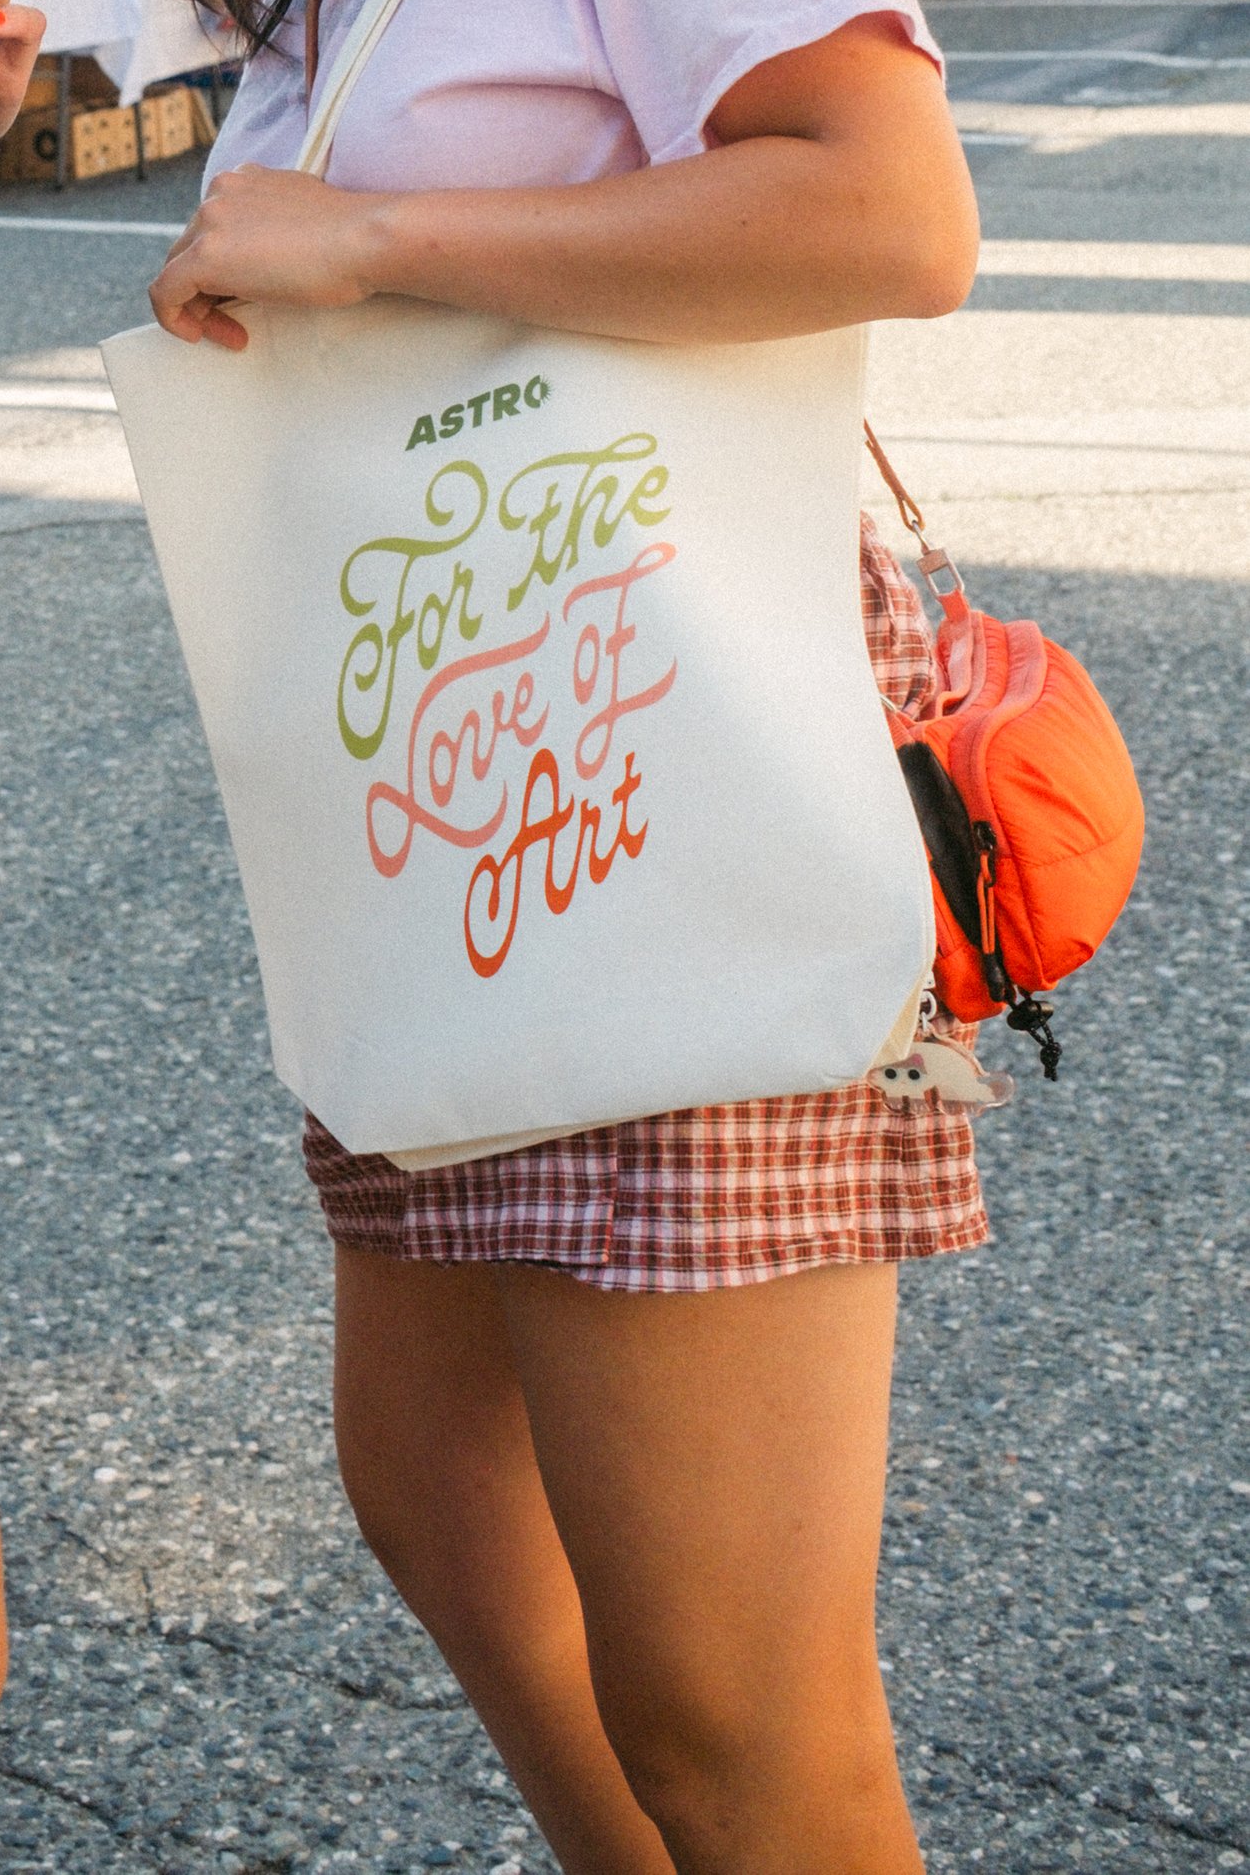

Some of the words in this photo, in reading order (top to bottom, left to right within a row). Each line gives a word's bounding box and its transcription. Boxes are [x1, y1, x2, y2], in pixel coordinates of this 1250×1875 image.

[404, 374, 552, 452] ASTRO
[337, 460, 489, 760] For
[366, 611, 549, 878] Love
[563, 542, 677, 780] of
[464, 748, 649, 978] Art
